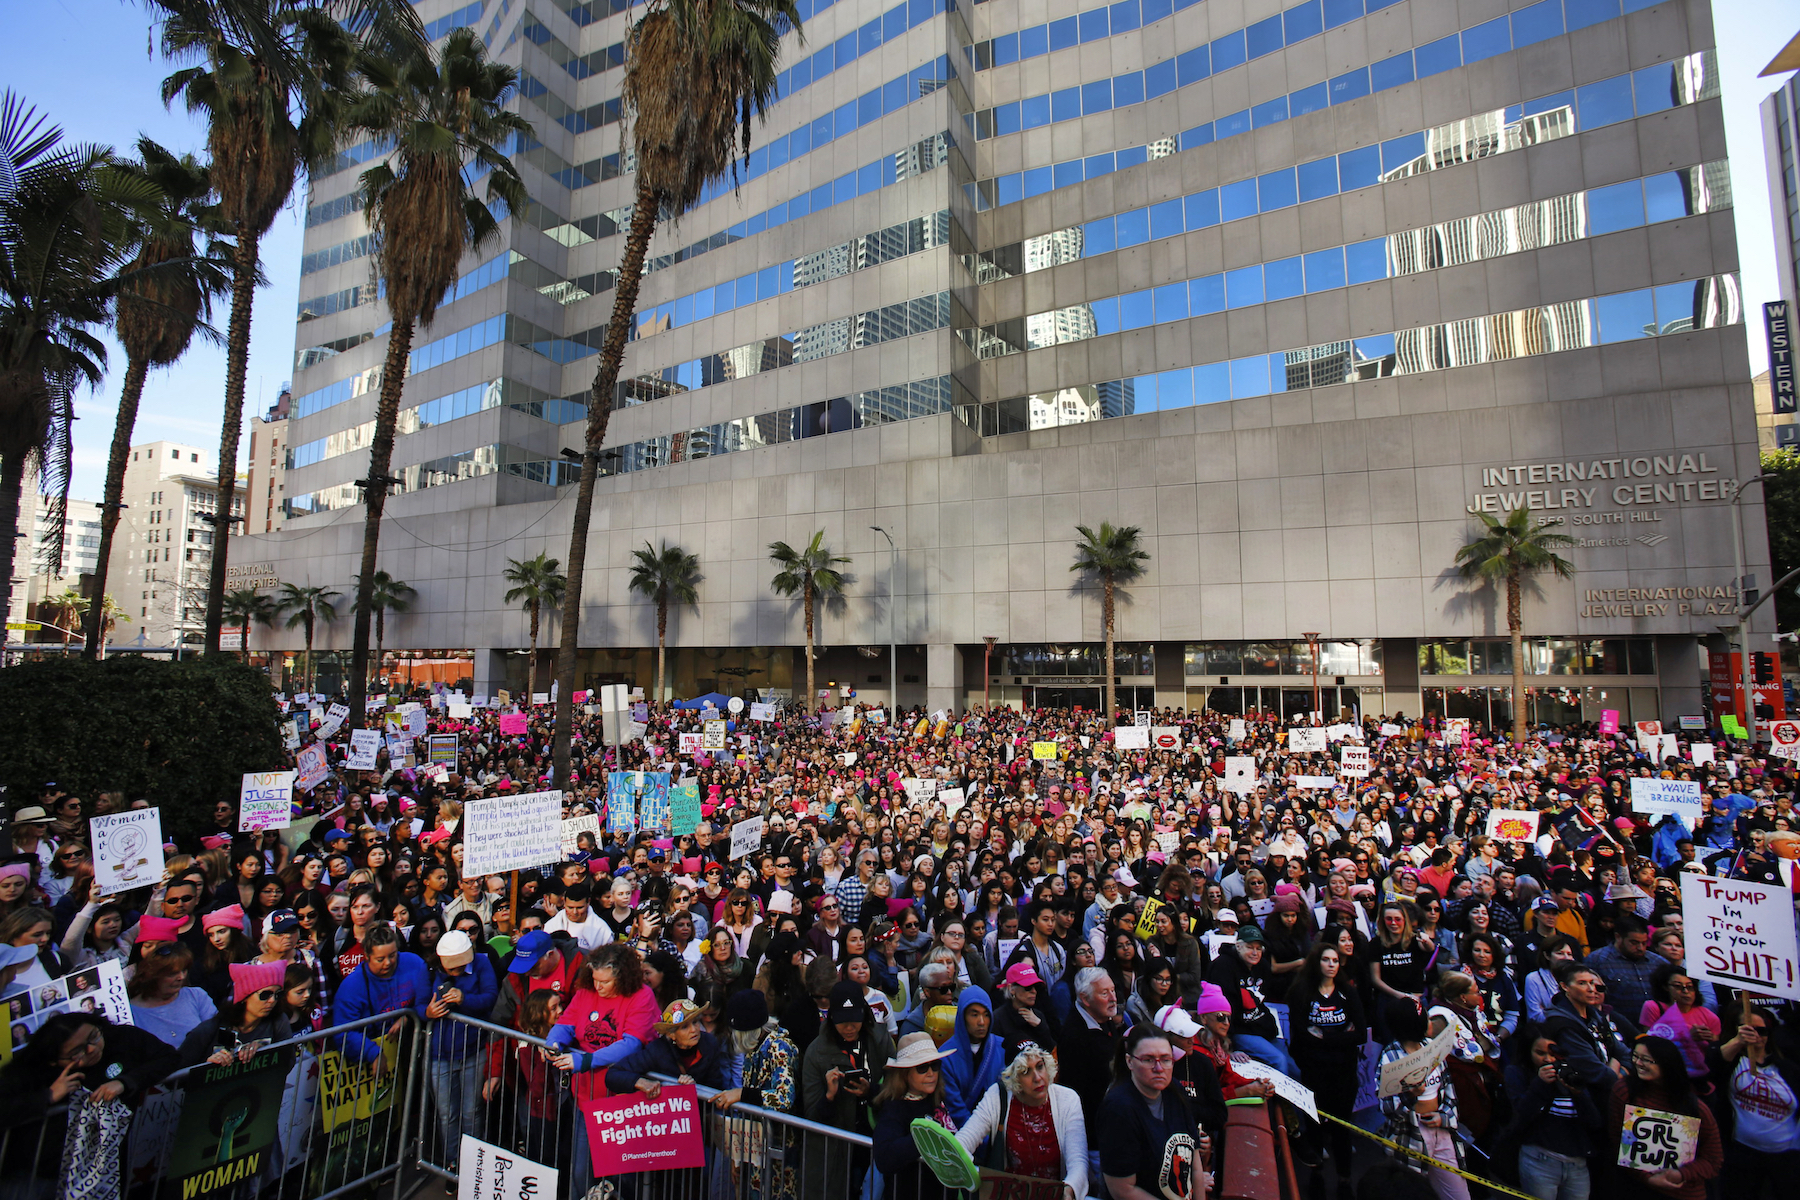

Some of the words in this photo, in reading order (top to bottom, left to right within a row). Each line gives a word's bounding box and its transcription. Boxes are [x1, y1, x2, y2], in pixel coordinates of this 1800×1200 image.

[1767, 304, 1794, 409] WESTERN
[1482, 453, 1718, 488] INTERNATIONAL
[1466, 487, 1597, 514] JEWELRY
[1612, 478, 1740, 506] CENTER
[1572, 512, 1624, 526] SOUTH
[1630, 510, 1662, 523] HILL
[1579, 537, 1630, 548] America
[225, 564, 275, 577] TERNATIONAL
[1586, 586, 1737, 603] INTERNATIONAL
[1580, 603, 1669, 618] JEWELRY
[1678, 602, 1741, 616] PLAZA
[299, 751, 317, 769] NO
[253, 773, 283, 787] NOT
[244, 788, 288, 801] JUST
[1660, 782, 1695, 794] WAVE
[611, 794, 626, 803] I'M
[643, 798, 660, 807] I'M
[1650, 793, 1701, 804] BREAKING
[242, 801, 289, 812] SOMEONE'S
[608, 802, 635, 812] WITH
[641, 806, 667, 815] WITH
[91, 809, 157, 828] Women's
[568, 816, 598, 833] SHOULD
[610, 811, 634, 827] HER
[643, 814, 663, 828] HER
[1501, 820, 1523, 829] GRL
[469, 822, 480, 832] All
[745, 827, 754, 835] FOR
[1504, 828, 1527, 838] PWR
[467, 832, 487, 844] They
[487, 832, 503, 842] were
[733, 838, 746, 847] WOMEN
[742, 843, 750, 851] FOR
[748, 843, 760, 851] WOMEN
[101, 885, 112, 893] THE
[1707, 915, 1757, 935] Tired
[1704, 946, 1793, 988] SHIT!
[1308, 1013, 1346, 1024] PERSISTED
[205, 1062, 241, 1084] FIGHT
[242, 1053, 269, 1074] LIKE
[270, 1051, 279, 1065] A
[1384, 1063, 1404, 1075] WHO
[1405, 1055, 1421, 1068] RUN
[324, 1066, 374, 1092] VOICE
[593, 1101, 666, 1124] Together
[668, 1097, 692, 1112] We
[1740, 1102, 1755, 1112] NOT
[330, 1121, 370, 1149] UNIED
[601, 1124, 643, 1145] Fight
[645, 1120, 668, 1137] for
[670, 1117, 691, 1134] All
[1632, 1116, 1680, 1150] GRL
[627, 1152, 648, 1160] Planned
[647, 1149, 677, 1158] Parenthood
[1630, 1142, 1679, 1170] PWR
[182, 1151, 260, 1200] WOMAN
